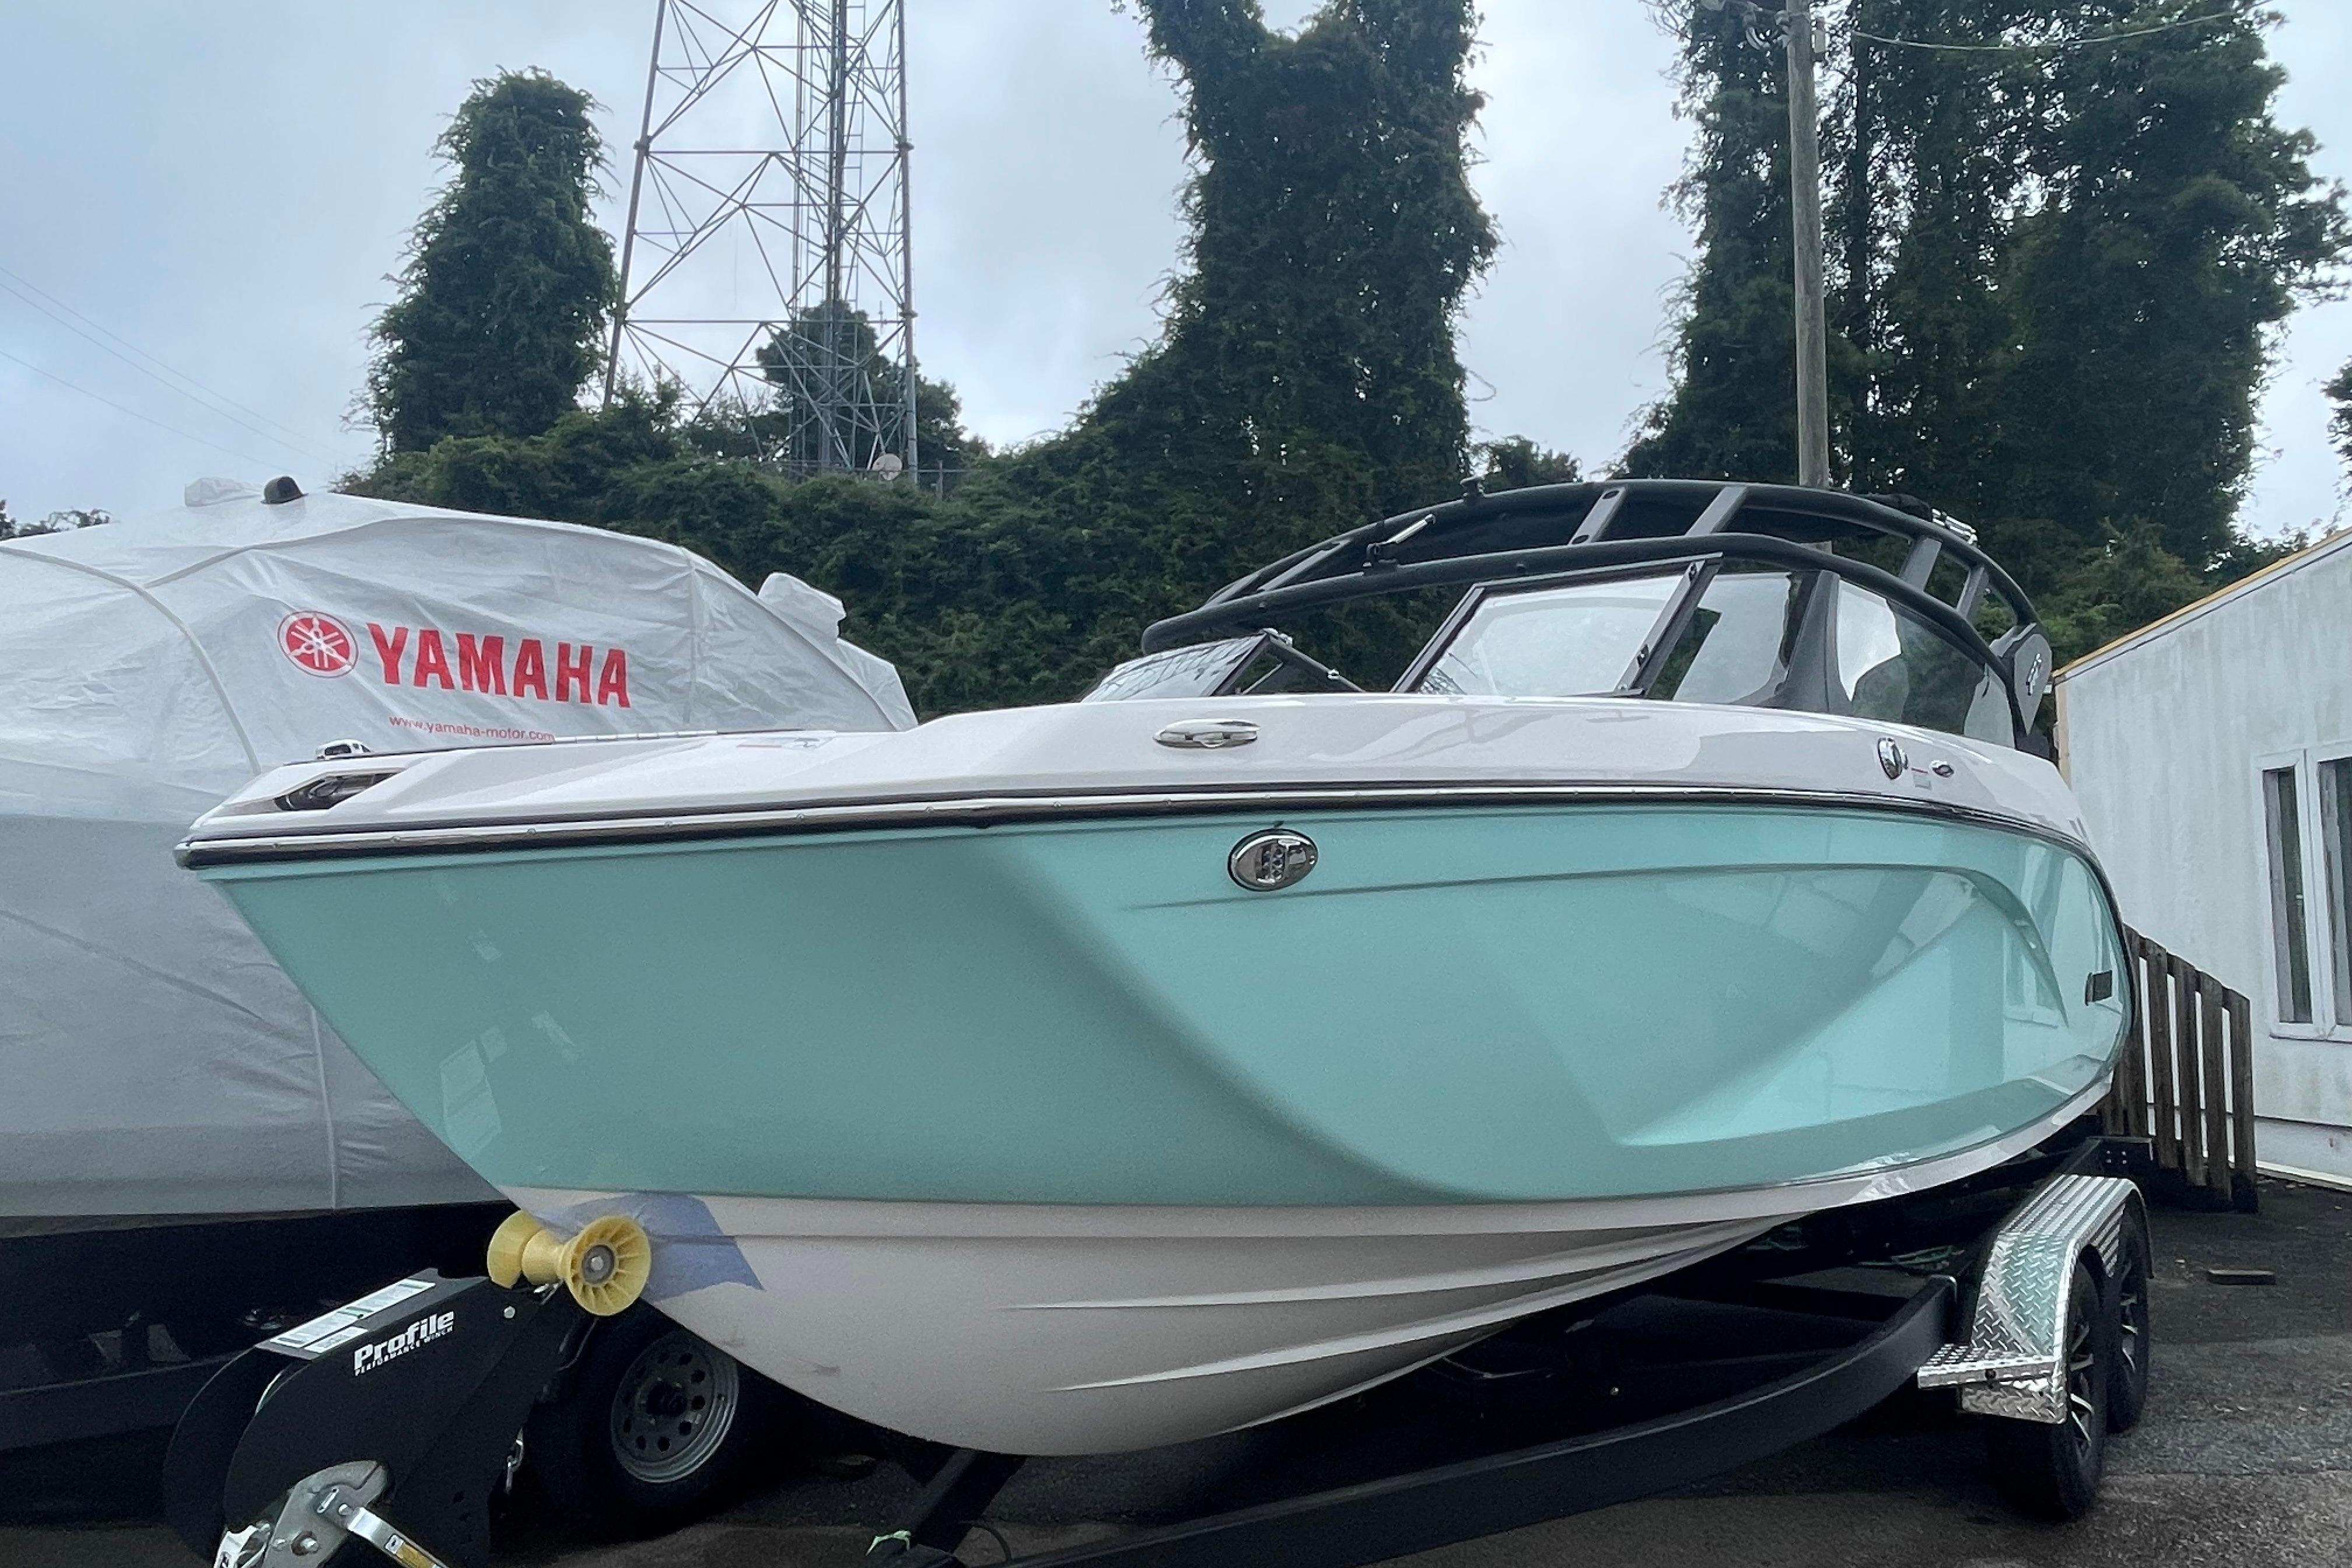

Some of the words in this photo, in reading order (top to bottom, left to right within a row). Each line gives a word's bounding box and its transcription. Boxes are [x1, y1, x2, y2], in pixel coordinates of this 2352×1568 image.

[366, 622, 631, 708] YAMAHA
[388, 716, 555, 742] www.yamaha-motor.com
[354, 1311, 454, 1370] Profile
